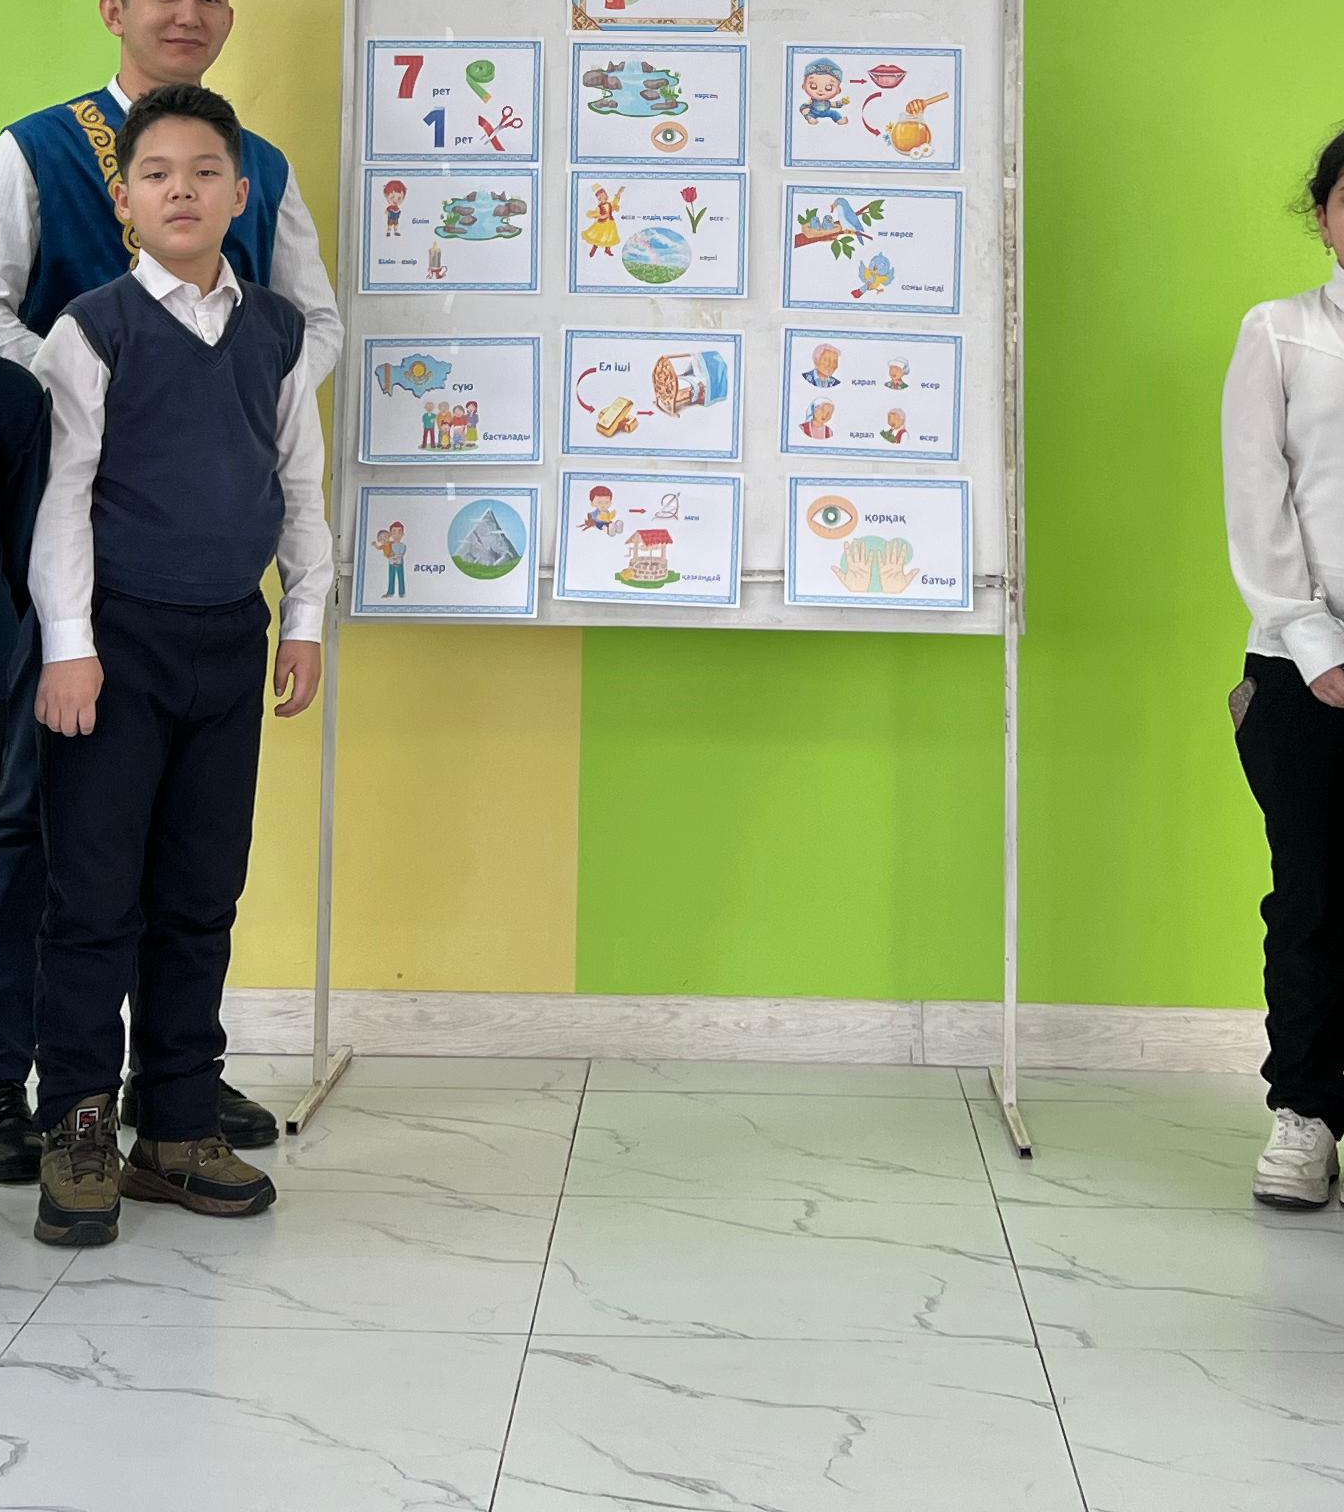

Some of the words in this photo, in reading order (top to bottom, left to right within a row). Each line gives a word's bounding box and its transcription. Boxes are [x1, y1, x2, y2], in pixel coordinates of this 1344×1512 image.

[394, 55, 424, 99] 7
[432, 87, 451, 97] рет
[422, 107, 445, 148] 1
[454, 136, 473, 146] рет
[599, 361, 612, 372] Ел
[482, 431, 531, 441] басталады
[864, 513, 907, 524] қорқақ
[413, 563, 446, 575] асқар
[921, 574, 957, 587] батыр
